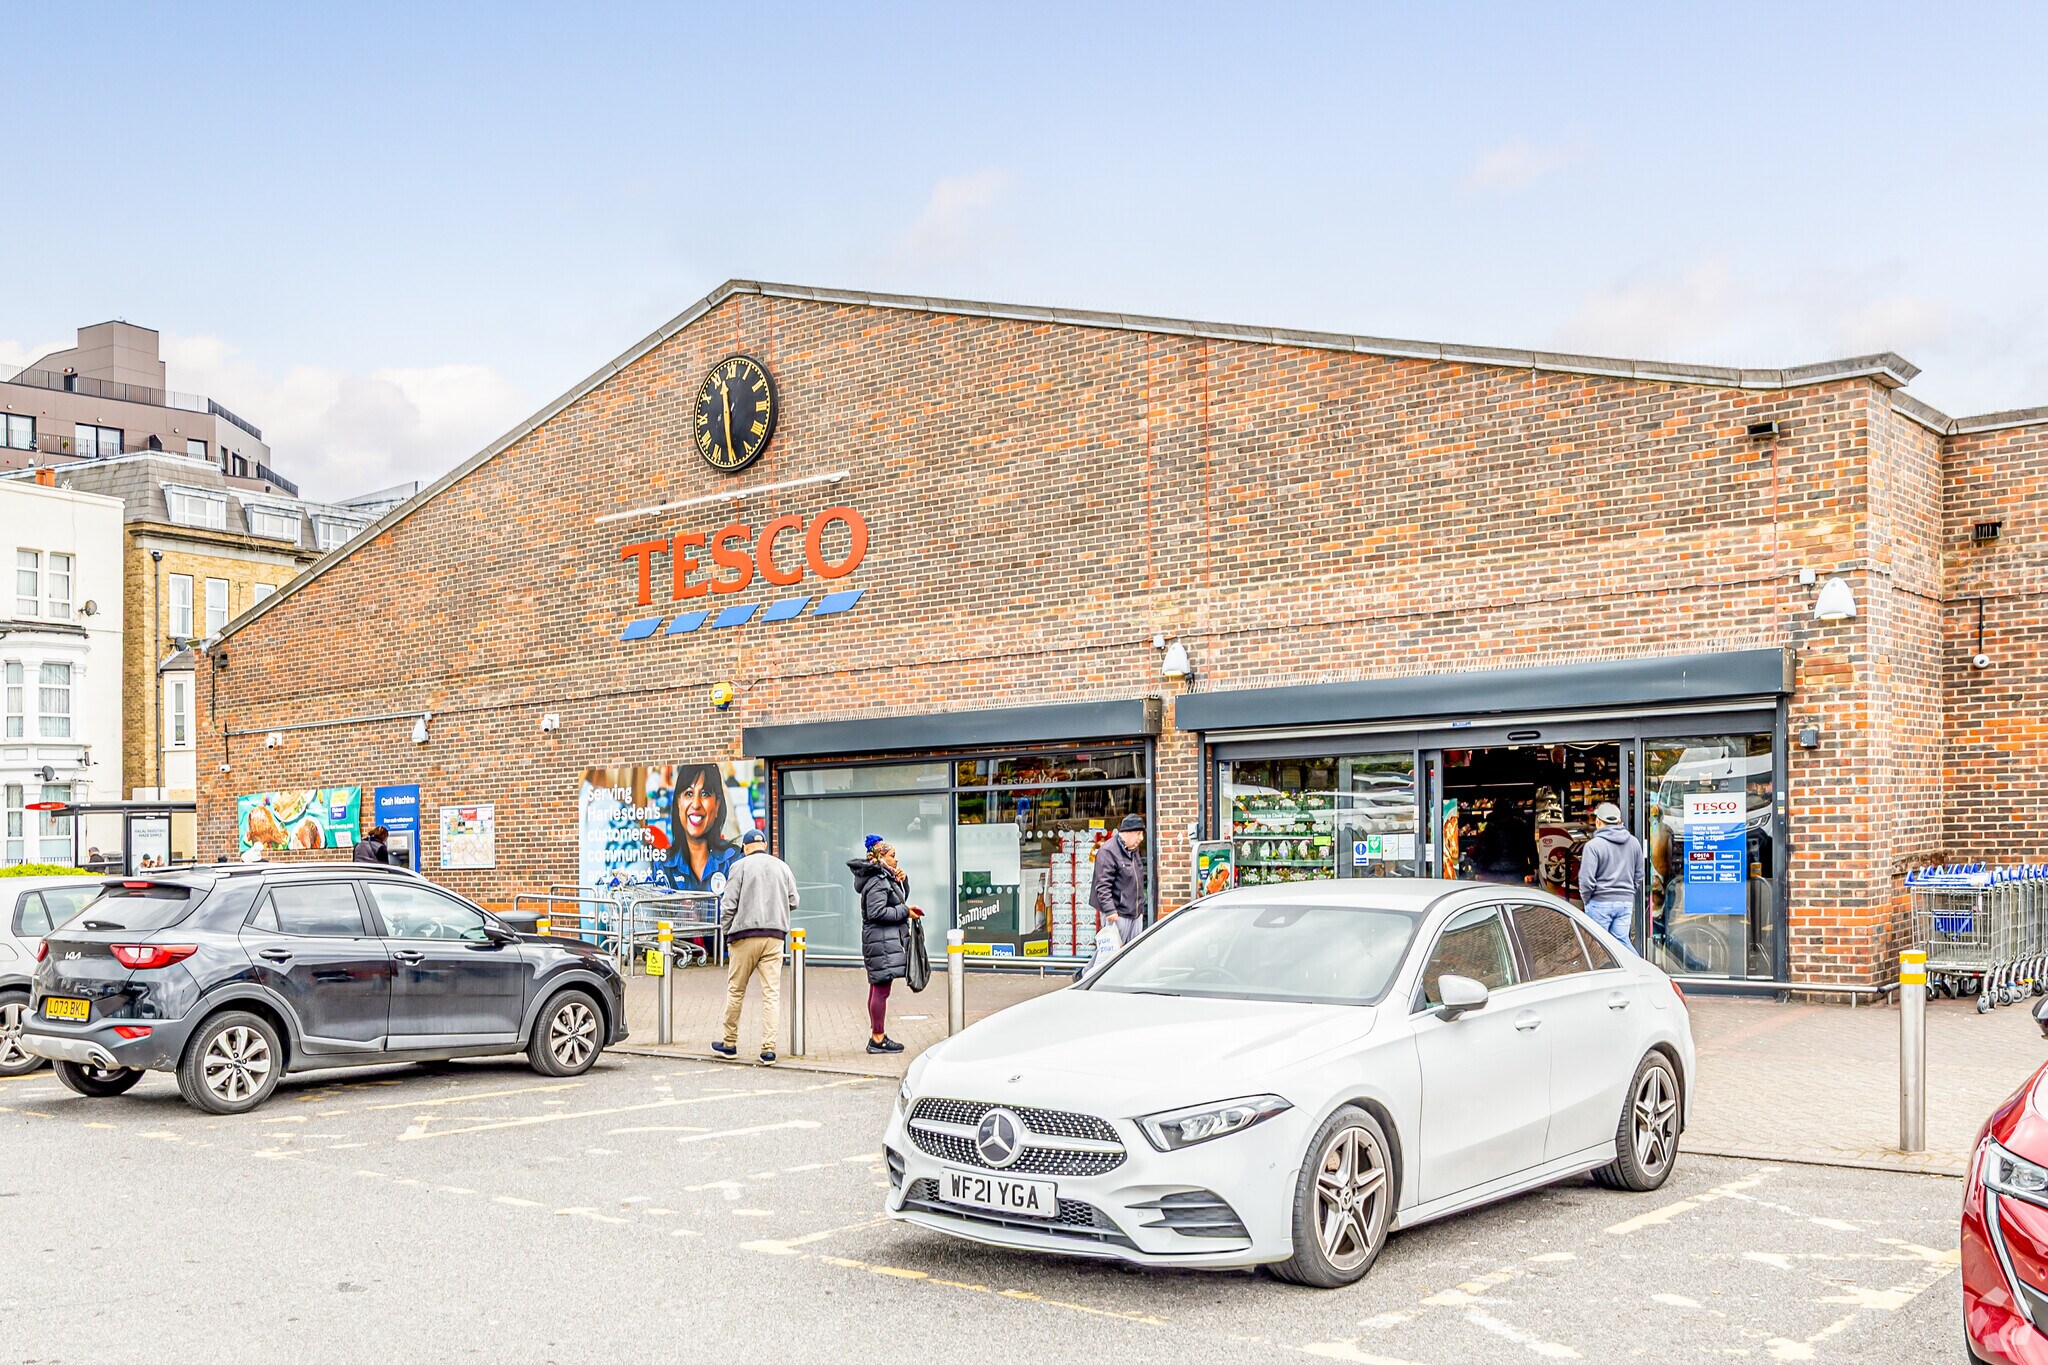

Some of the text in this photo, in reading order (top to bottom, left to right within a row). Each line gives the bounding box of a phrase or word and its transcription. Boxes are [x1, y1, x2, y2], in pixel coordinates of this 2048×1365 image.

[620, 506, 868, 606] TESCO
[1000, 776, 1035, 785] Easter
[381, 796, 416, 806] Cash Machine
[587, 784, 633, 803] Serving
[587, 804, 661, 822] Harlesden's
[1693, 802, 1737, 811] TESCO
[587, 825, 655, 844] customers,
[587, 845, 667, 862] communities
[65, 951, 81, 960] KIA
[1025, 947, 1048, 955] Clubcard
[70, 1002, 85, 1016] BKL
[951, 1174, 1039, 1210] WF21 YGA
